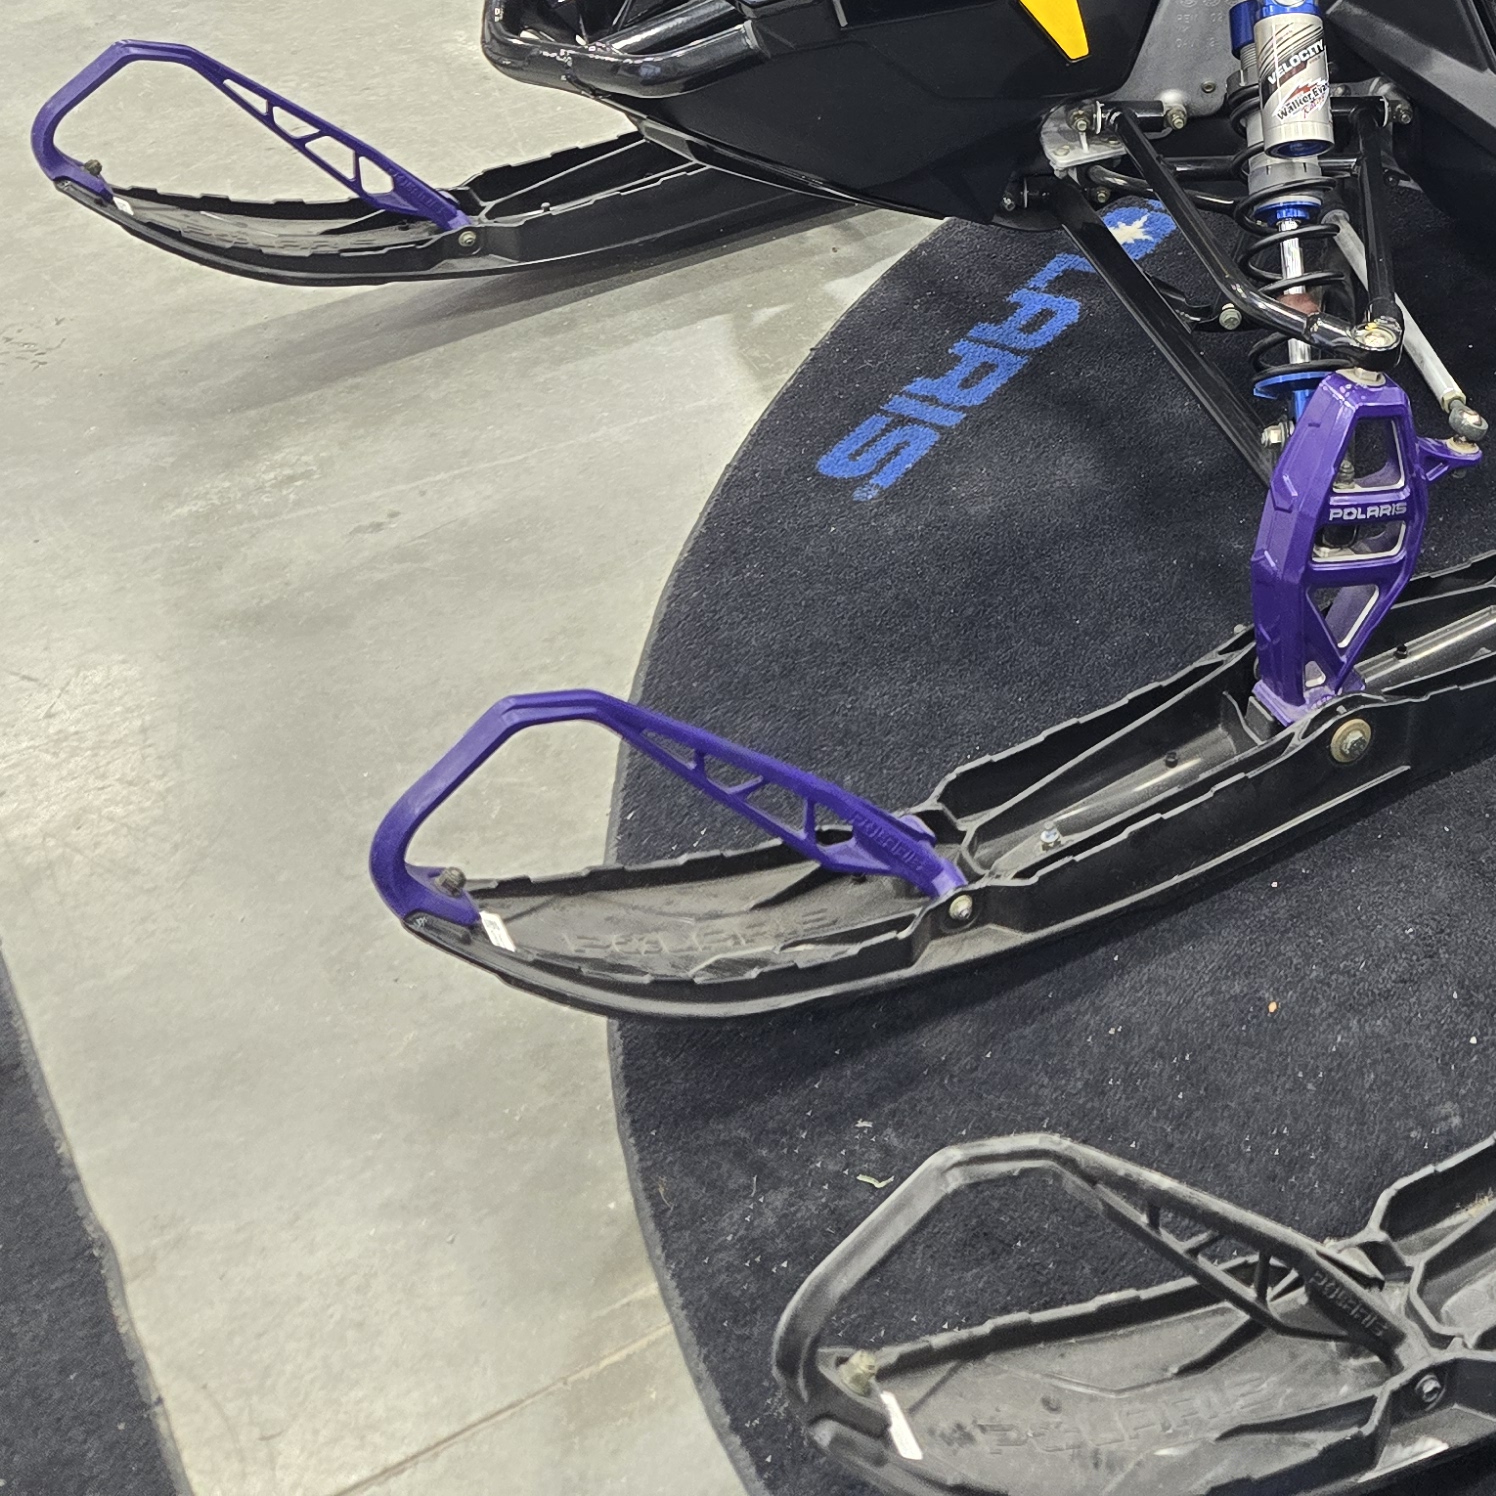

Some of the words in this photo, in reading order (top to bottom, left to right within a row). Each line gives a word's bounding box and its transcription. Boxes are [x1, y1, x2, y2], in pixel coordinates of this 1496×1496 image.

[1268, 39, 1324, 84] VELOCITY
[816, 201, 1177, 501] OLARIS
[1329, 502, 1407, 521] POLARIS
